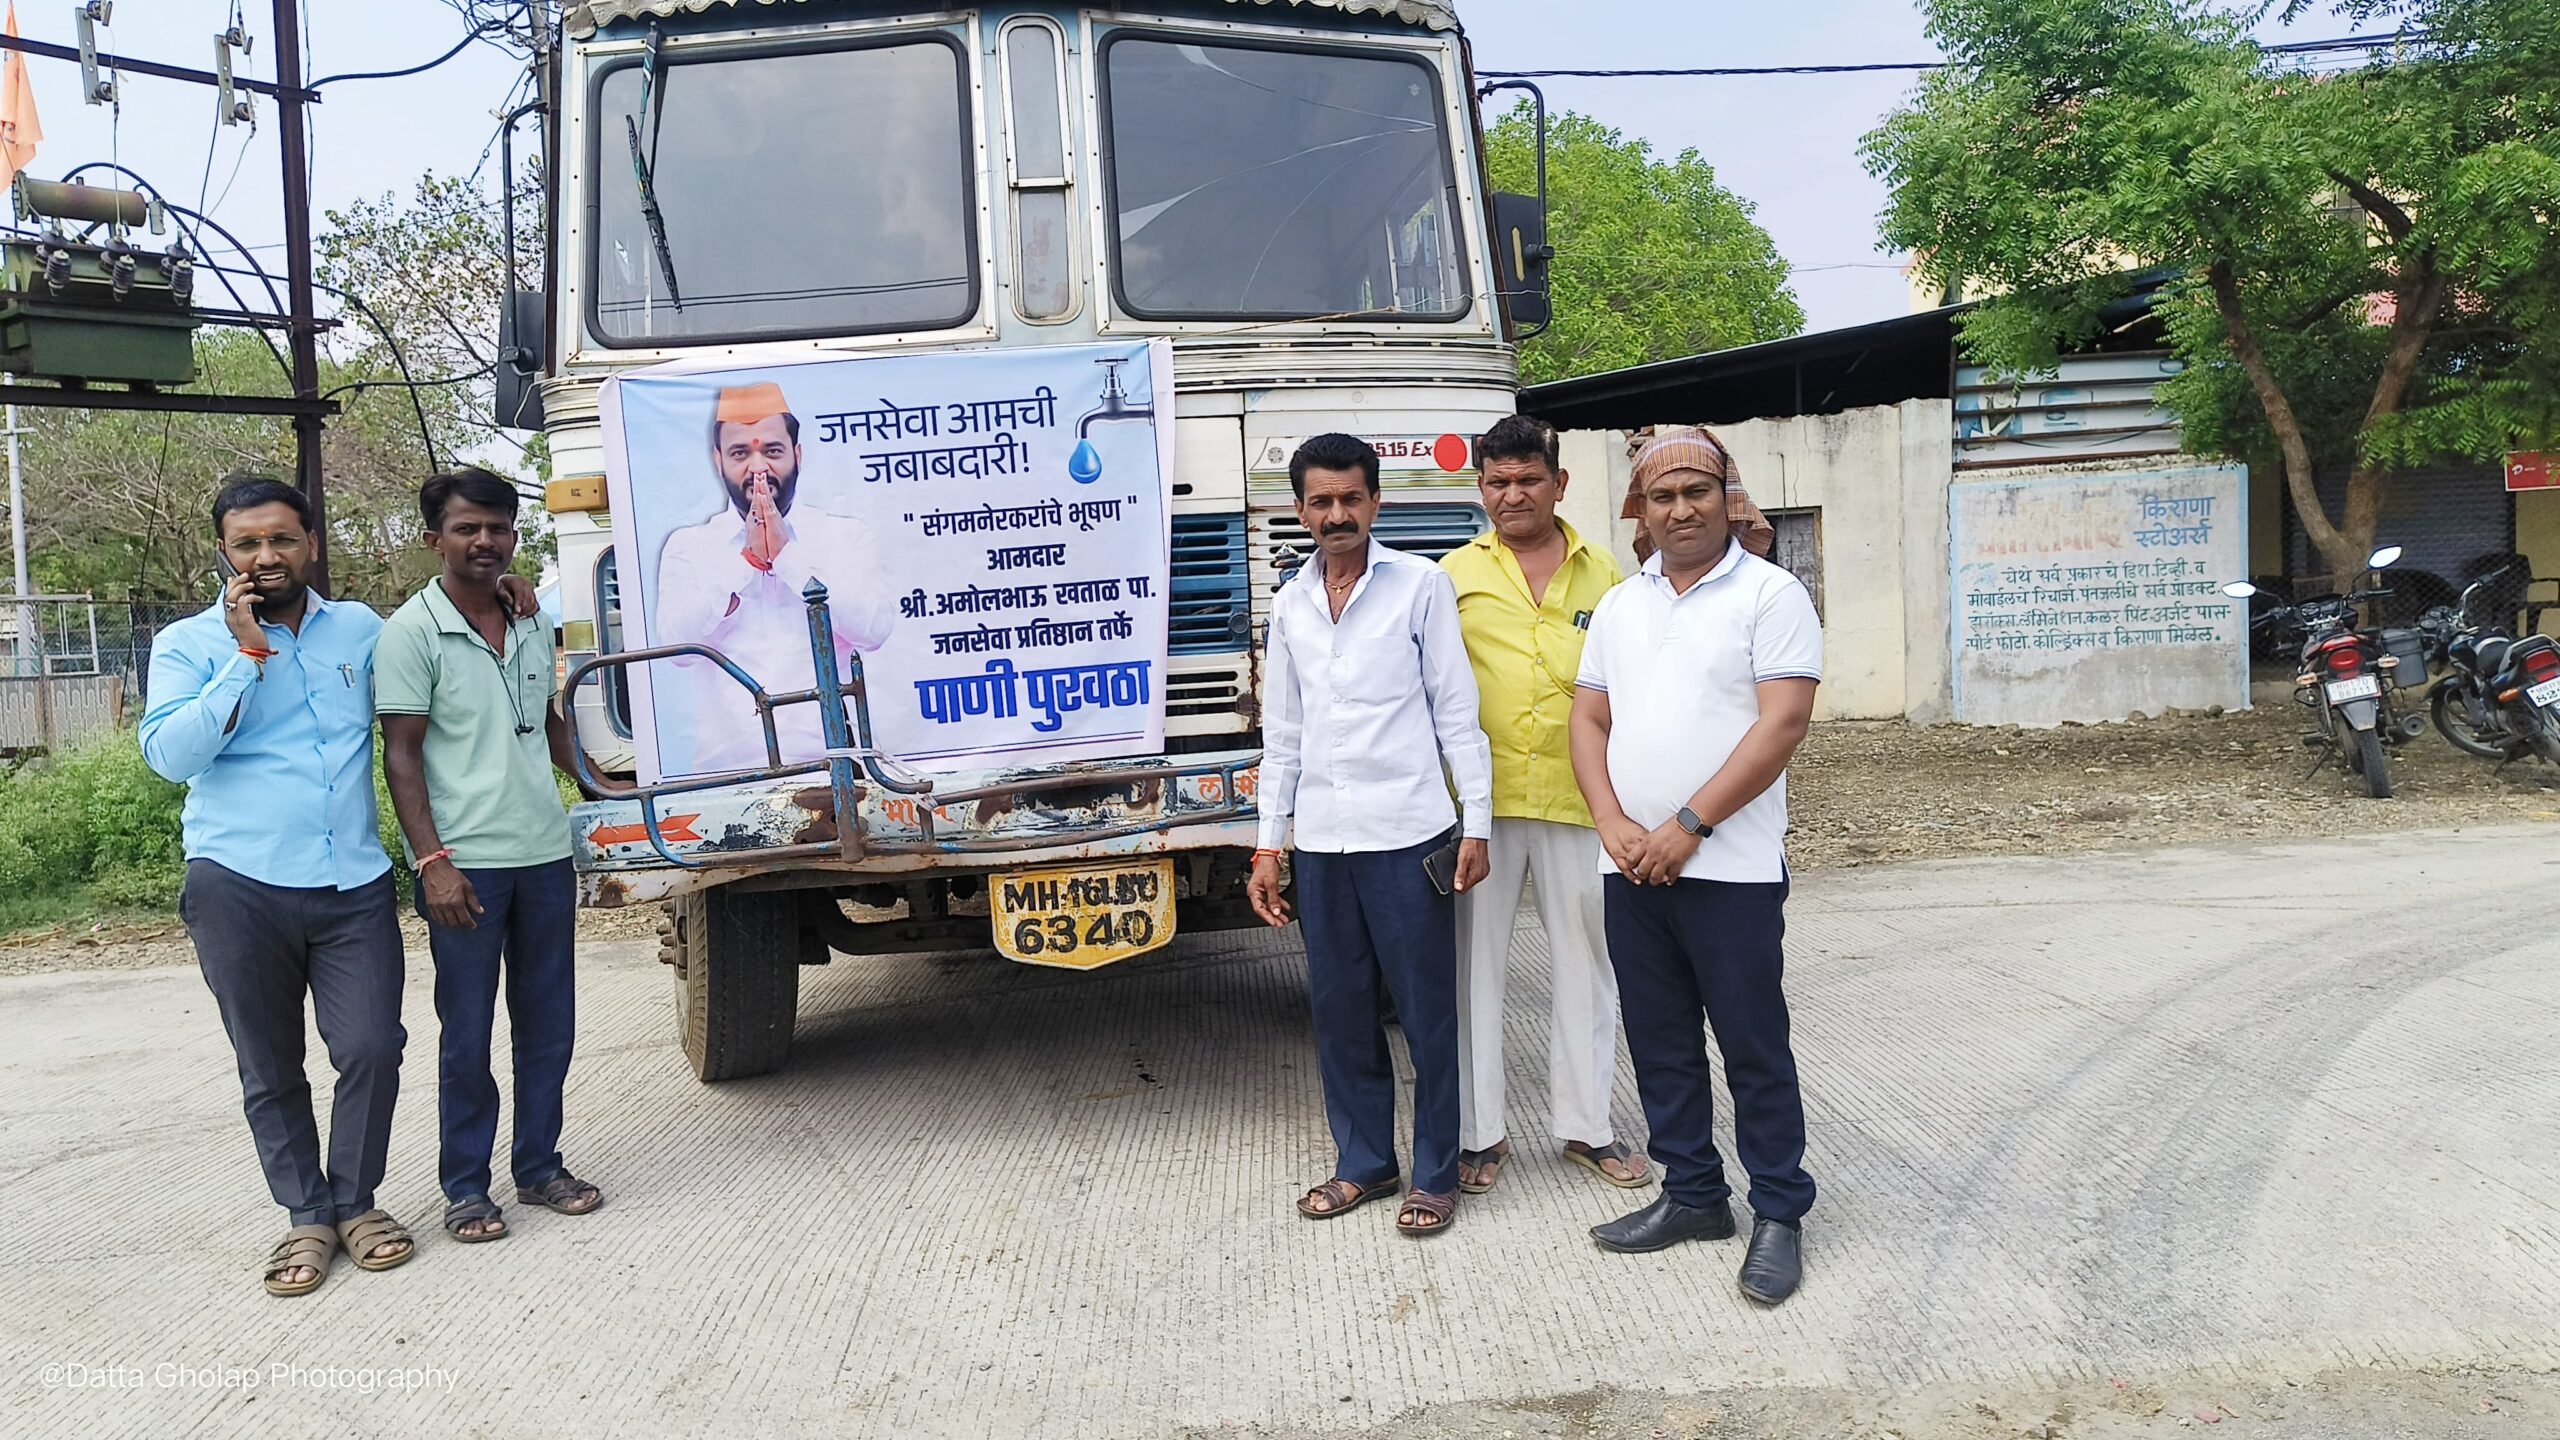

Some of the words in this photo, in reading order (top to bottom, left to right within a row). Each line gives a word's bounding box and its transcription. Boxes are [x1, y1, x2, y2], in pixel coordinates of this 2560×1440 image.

[815, 398, 941, 443] जनसेवा
[947, 386, 1057, 433] आमची
[860, 432, 1030, 484] जबाबदारी!
[1411, 441, 1433, 457] Ex
[2137, 494, 2216, 519] किराणा
[2133, 518, 2213, 547] स्टोअर्स
[986, 544, 1066, 571] आमदार
[2001, 565, 2032, 583] येथे
[2036, 563, 2062, 583] सर्व
[1053, 578, 1120, 606] खताळ
[1126, 576, 1157, 599] पा.
[2143, 578, 2168, 599] सर्व
[930, 623, 1012, 655] जनसेवा
[1015, 618, 1094, 649] प्रतिष्ठान
[1095, 611, 1133, 641] तर्फे
[2113, 625, 2163, 646] किराणा
[914, 658, 1018, 724] पाणी
[1022, 660, 1152, 733] पुरवठा
